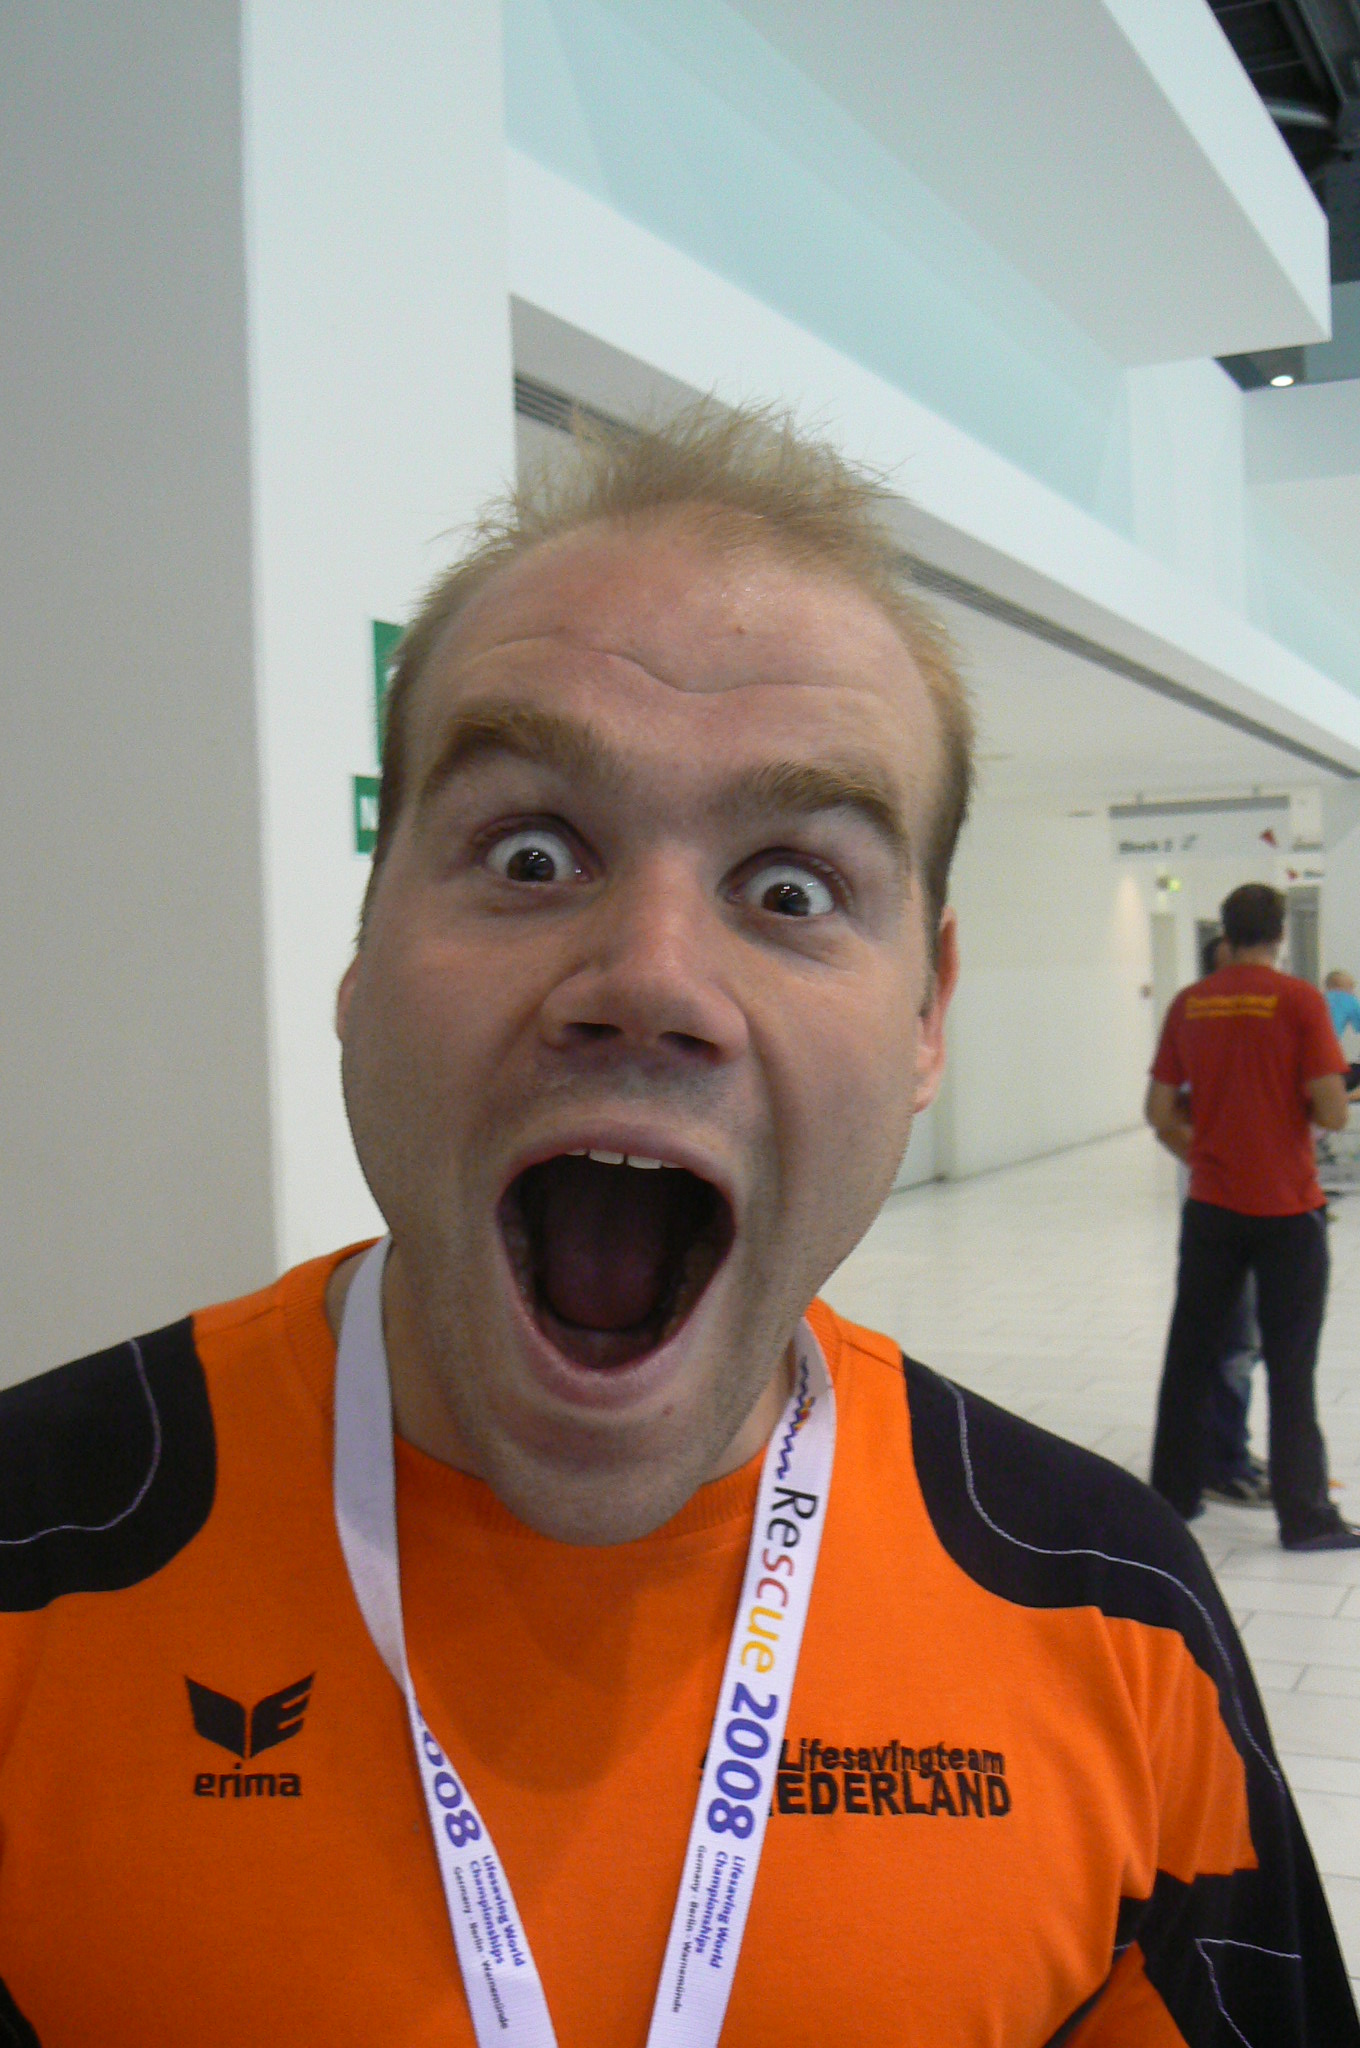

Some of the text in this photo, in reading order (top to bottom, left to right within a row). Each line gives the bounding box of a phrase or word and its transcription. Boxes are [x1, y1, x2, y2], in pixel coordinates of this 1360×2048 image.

[707, 1486, 819, 1839] Rescue 2008
[194, 1762, 303, 1798] erima
[417, 1706, 481, 1847] 008
[769, 1770, 1012, 1818] EDERLAND
[779, 1738, 1006, 1779] Lifesavingteam
[454, 1866, 472, 1914] Germany
[470, 1922, 484, 1953] Berlin
[470, 1860, 504, 1964] Championships
[483, 1855, 526, 1967] Lifesaving World
[690, 1845, 706, 1892] Germany
[695, 1851, 728, 1954] Championships
[709, 1855, 746, 1969] Lifesaving World
[685, 1901, 699, 1932] Berlin
